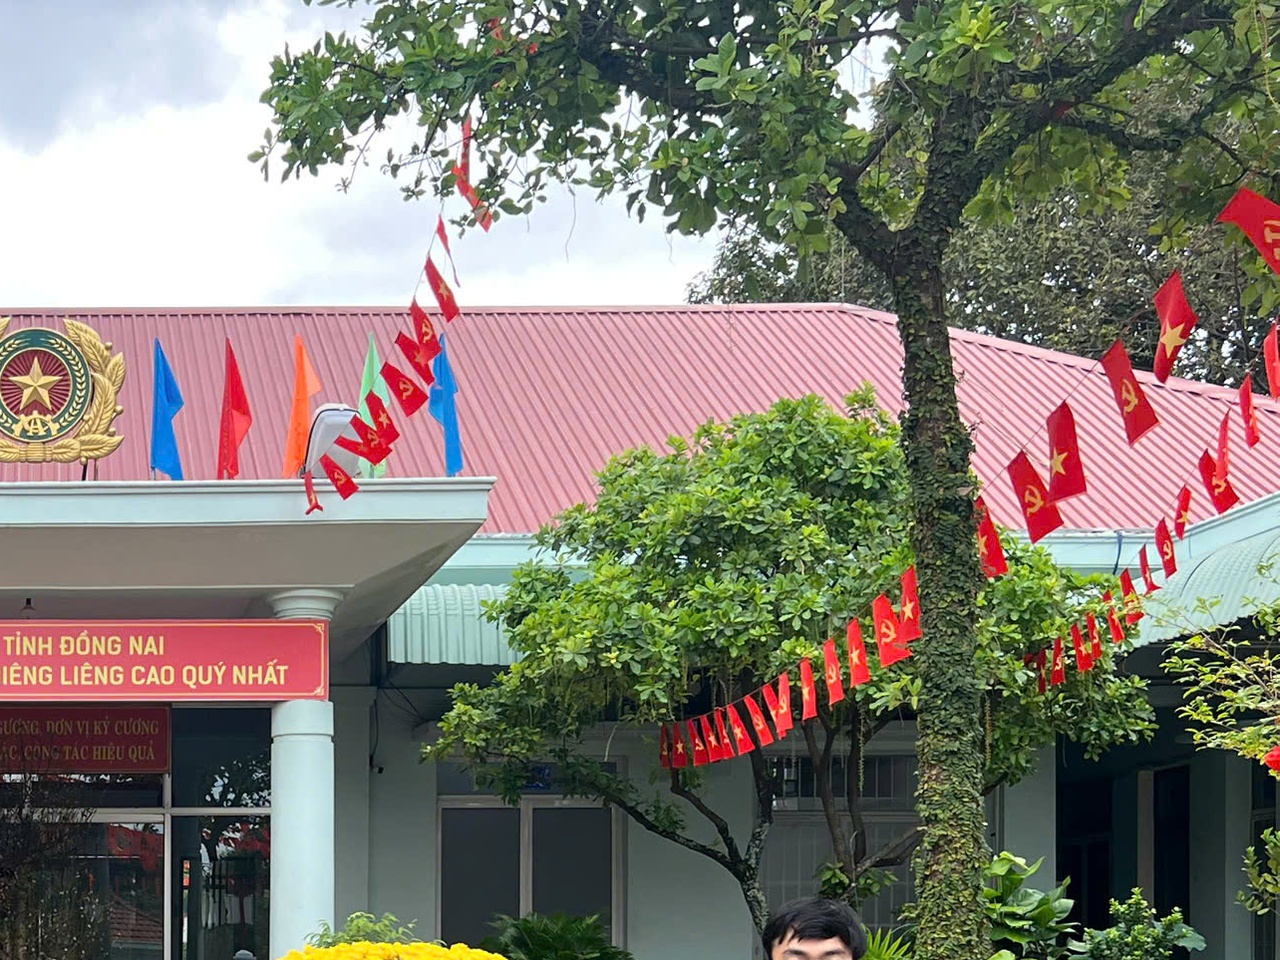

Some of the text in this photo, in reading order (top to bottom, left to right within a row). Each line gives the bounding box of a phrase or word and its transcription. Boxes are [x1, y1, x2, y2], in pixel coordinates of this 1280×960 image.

[3, 631, 53, 656] TỈNH
[59, 630, 122, 656] ĐỒNG
[129, 636, 165, 656] NAI
[60, 662, 124, 686] LIÊNG
[131, 665, 176, 686] CAO
[182, 661, 226, 688] QUÝ
[232, 659, 288, 686] NHẤT
[77, 720, 90, 738] VỊ
[114, 718, 159, 736] CƯƠNG
[63, 741, 89, 760] TÁC
[92, 742, 125, 763] HIỆU
[128, 739, 155, 763] QUẢ
